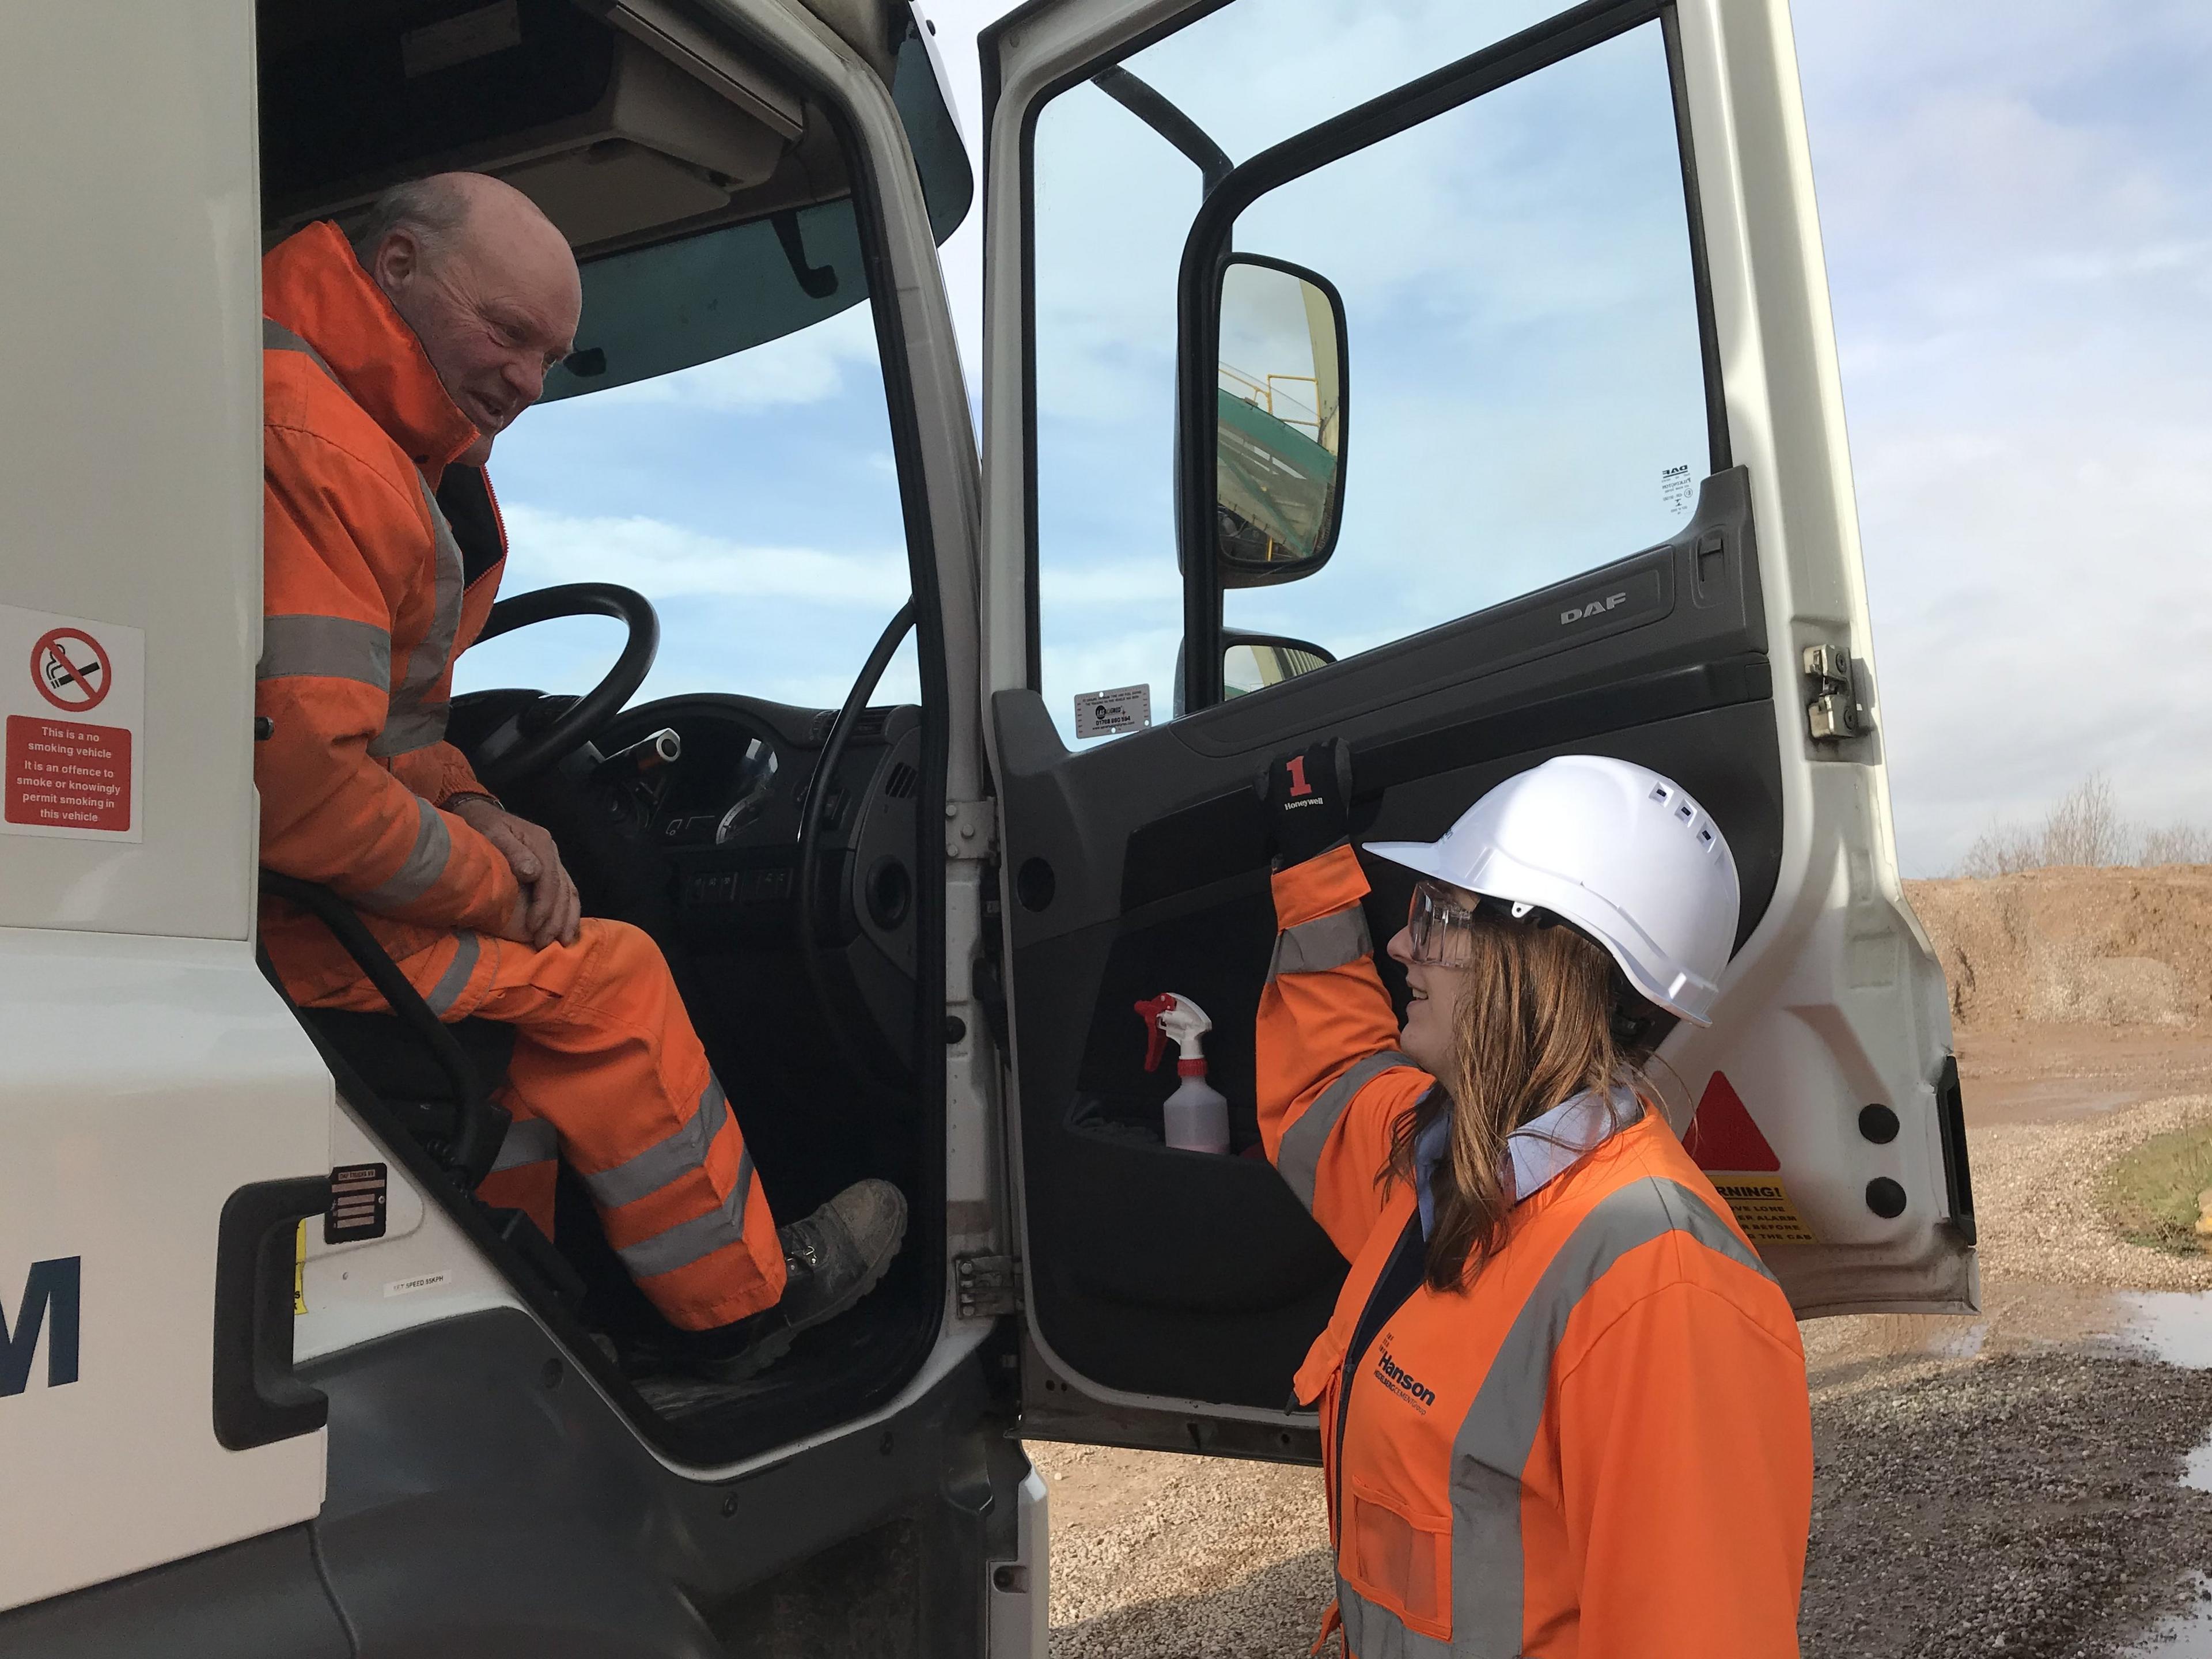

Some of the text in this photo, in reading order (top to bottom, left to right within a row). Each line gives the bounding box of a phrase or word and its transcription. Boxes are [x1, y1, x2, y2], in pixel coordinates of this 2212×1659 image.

[1560, 592, 1626, 625] DAF
[41, 726, 64, 738] This
[66, 730, 75, 739] is
[86, 734, 99, 742] no
[28, 743, 111, 758] smoking vehicle
[25, 760, 113, 778] It is an offence to
[1286, 755, 1312, 797] 1
[17, 777, 120, 796] smoke or knowingly
[23, 793, 115, 809] permit smoking in
[1284, 797, 1324, 810] Honeywell
[40, 808, 98, 821] this vehicle
[1715, 1186, 1782, 1197] RNING!
[406, 1279, 425, 1289] SPEED
[1378, 1351, 1435, 1407] Hanson
